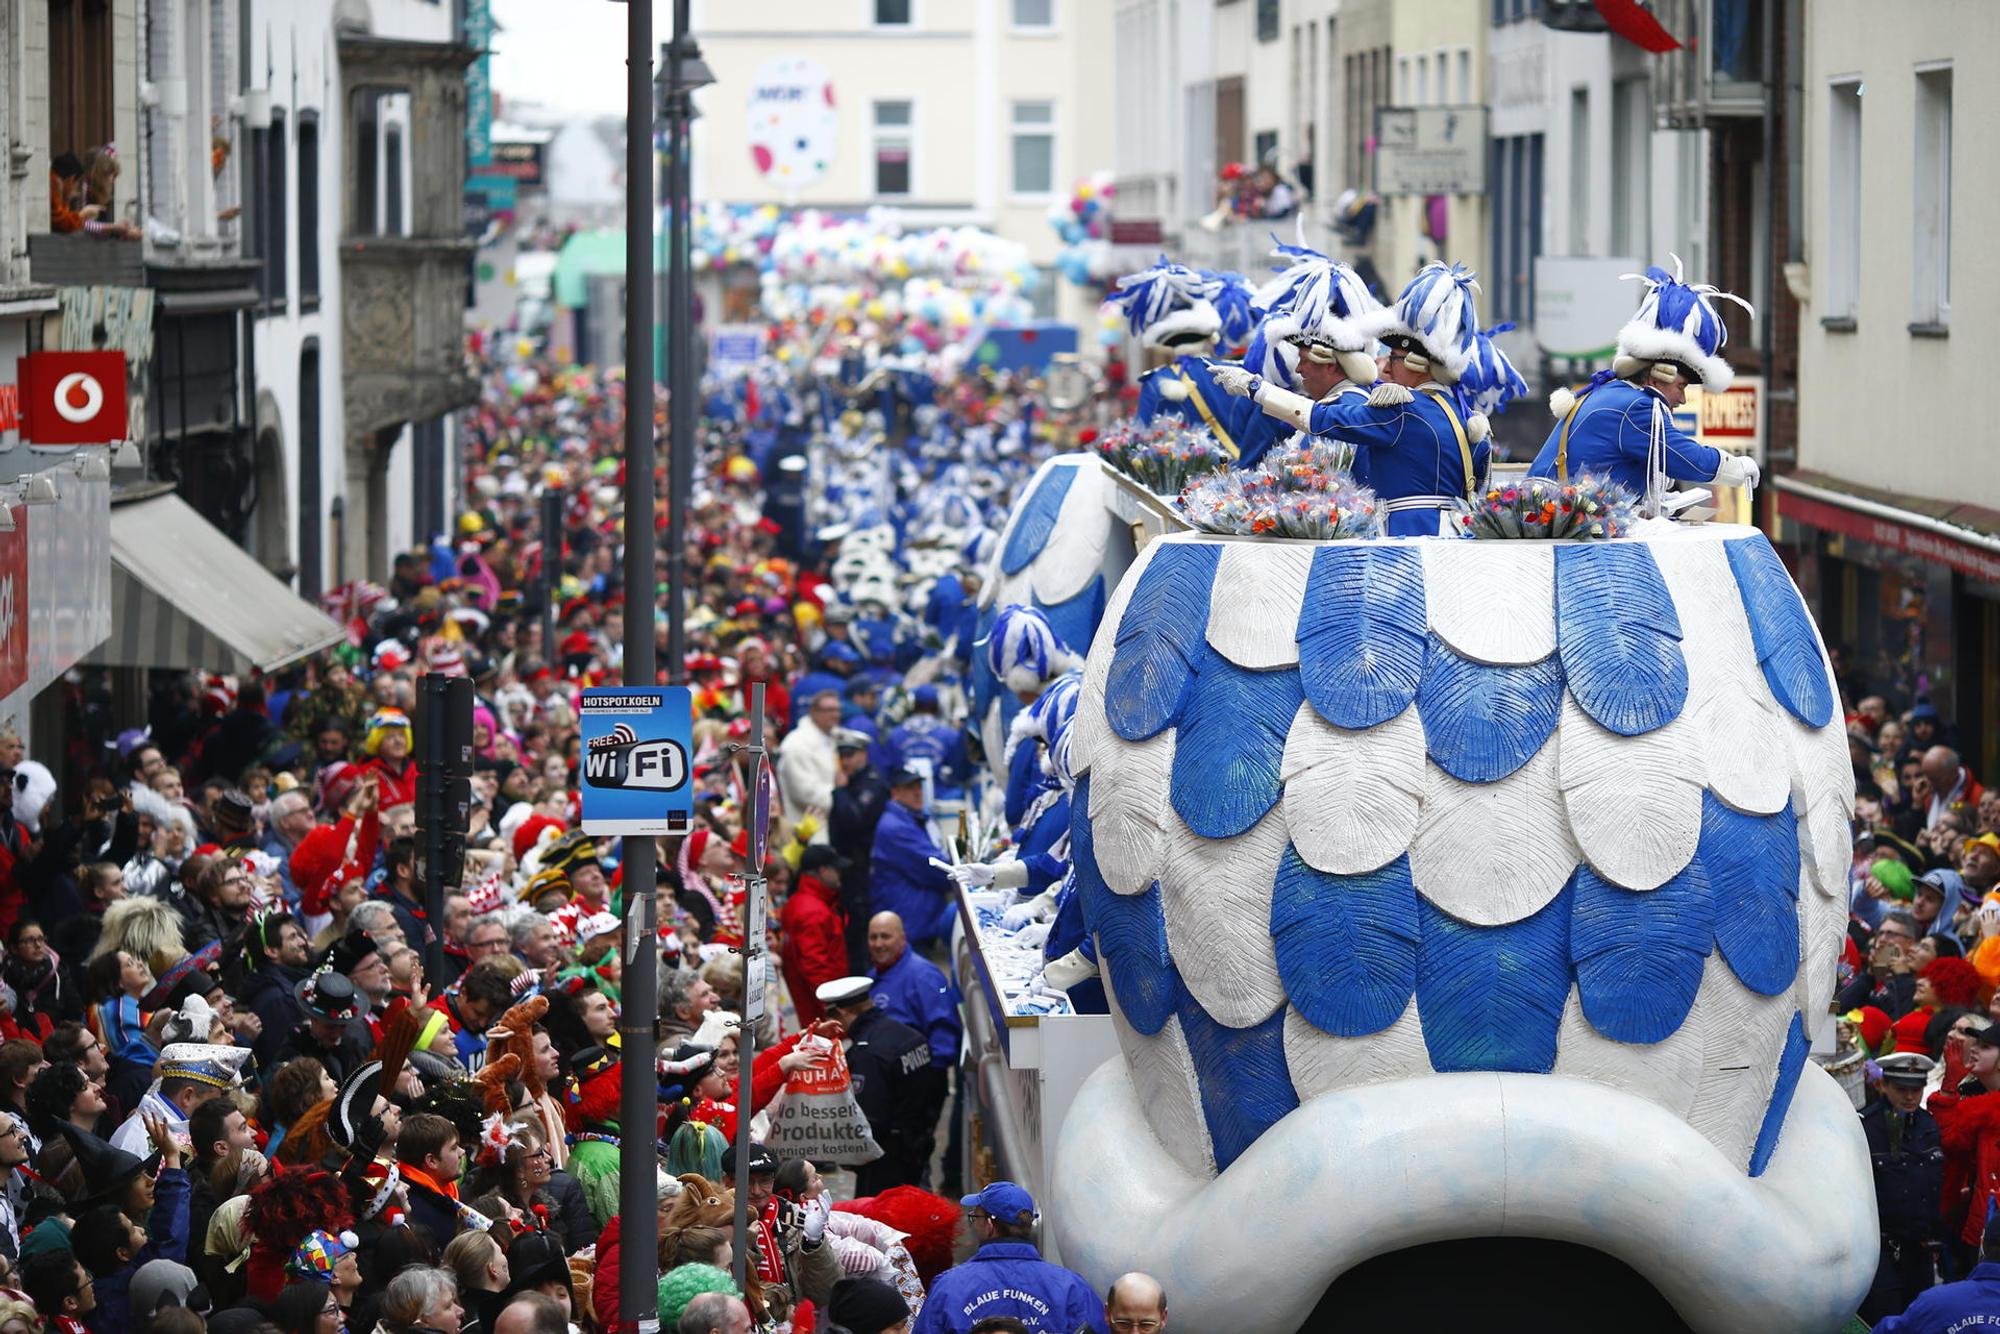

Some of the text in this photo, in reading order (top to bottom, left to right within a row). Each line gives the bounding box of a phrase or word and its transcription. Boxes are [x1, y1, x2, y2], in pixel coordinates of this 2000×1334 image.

[1703, 393, 1756, 429] EXPRESS
[583, 696, 660, 707] HOTSPOT.KOELN
[587, 735, 613, 749] FREE
[771, 1121, 866, 1142] Produkte
[822, 1141, 868, 1155] kosten!
[963, 1289, 1050, 1316] BLAUE FUNKEN
[1946, 1315, 1985, 1334] BLAUE
